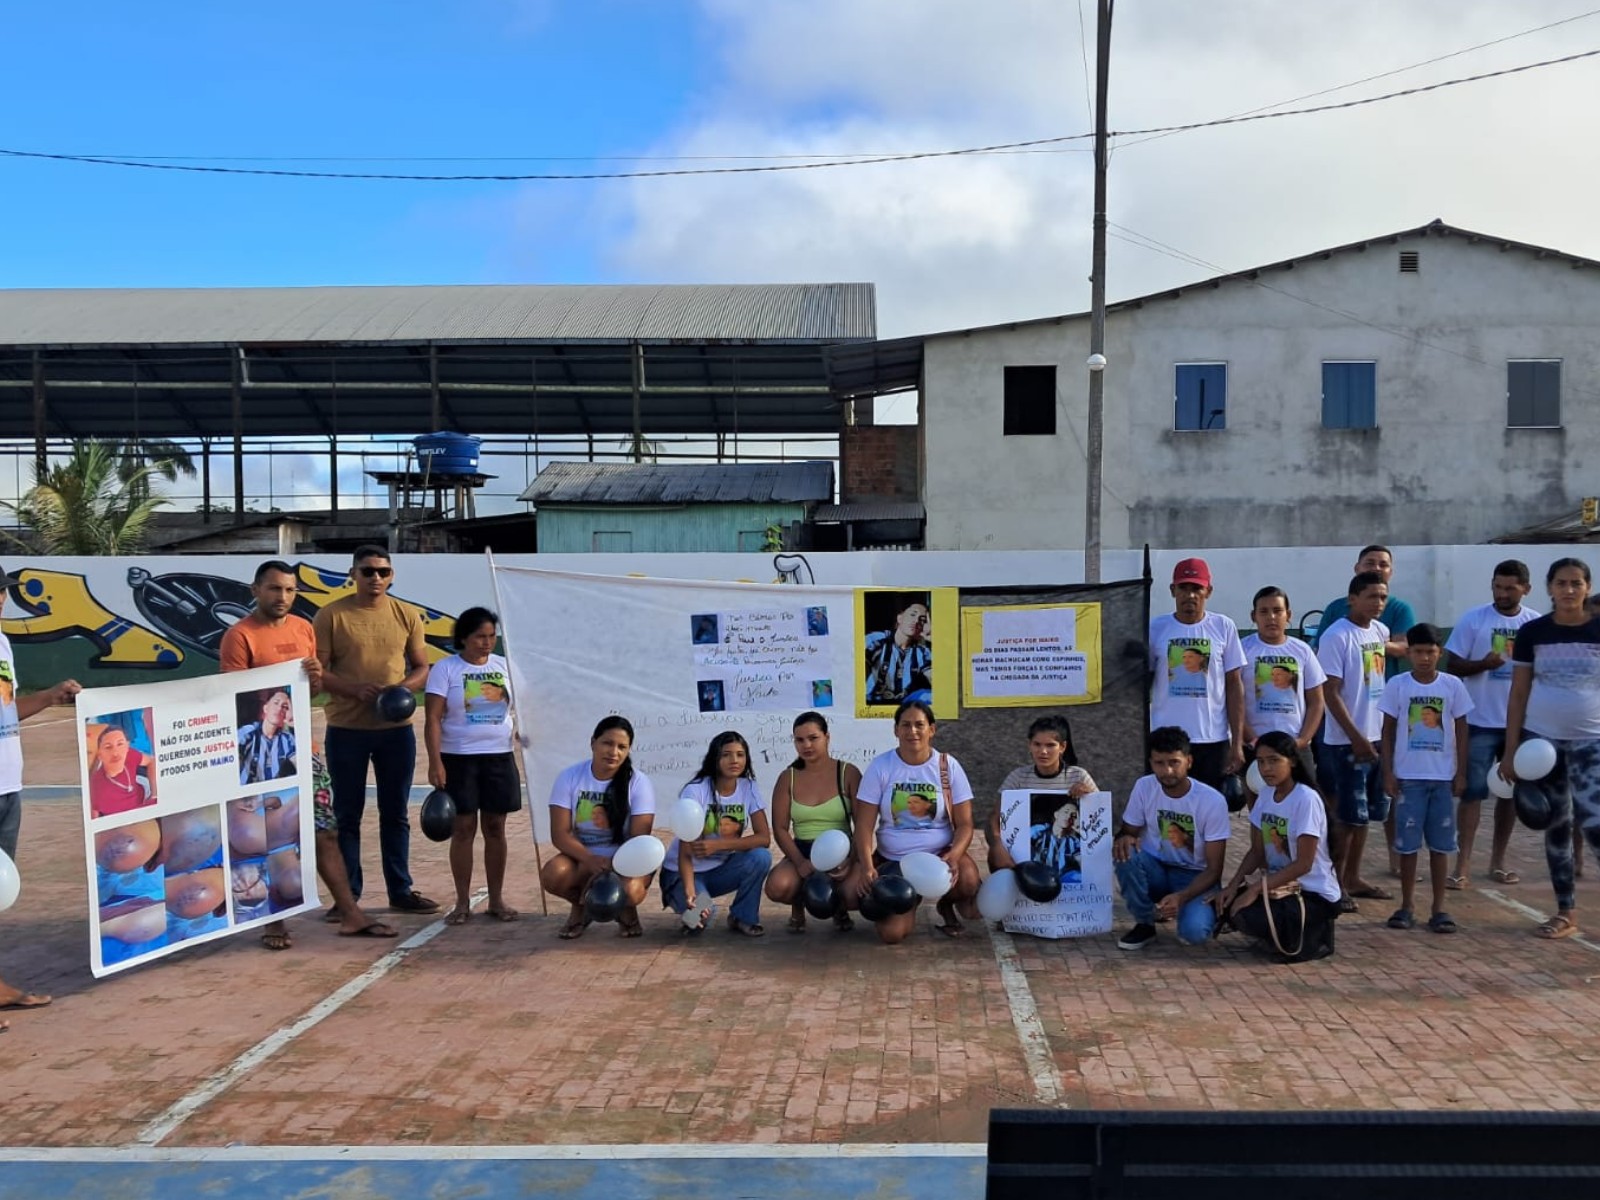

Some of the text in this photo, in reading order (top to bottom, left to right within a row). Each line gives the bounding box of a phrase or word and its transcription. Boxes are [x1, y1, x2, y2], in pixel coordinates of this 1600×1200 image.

[1169, 638, 1209, 647] MAIKO
[1256, 655, 1296, 665] MAIKO
[464, 671, 504, 681] MAIKO
[172, 720, 186, 730] FOI
[160, 726, 231, 747] NÃO FOI ACIDENTE
[158, 740, 235, 763] QUEREMOS JUSTIÇA
[160, 754, 235, 777] #TODOS POR MAIKO
[895, 783, 936, 792] MAIKO
[1158, 809, 1194, 824] MAIKO
